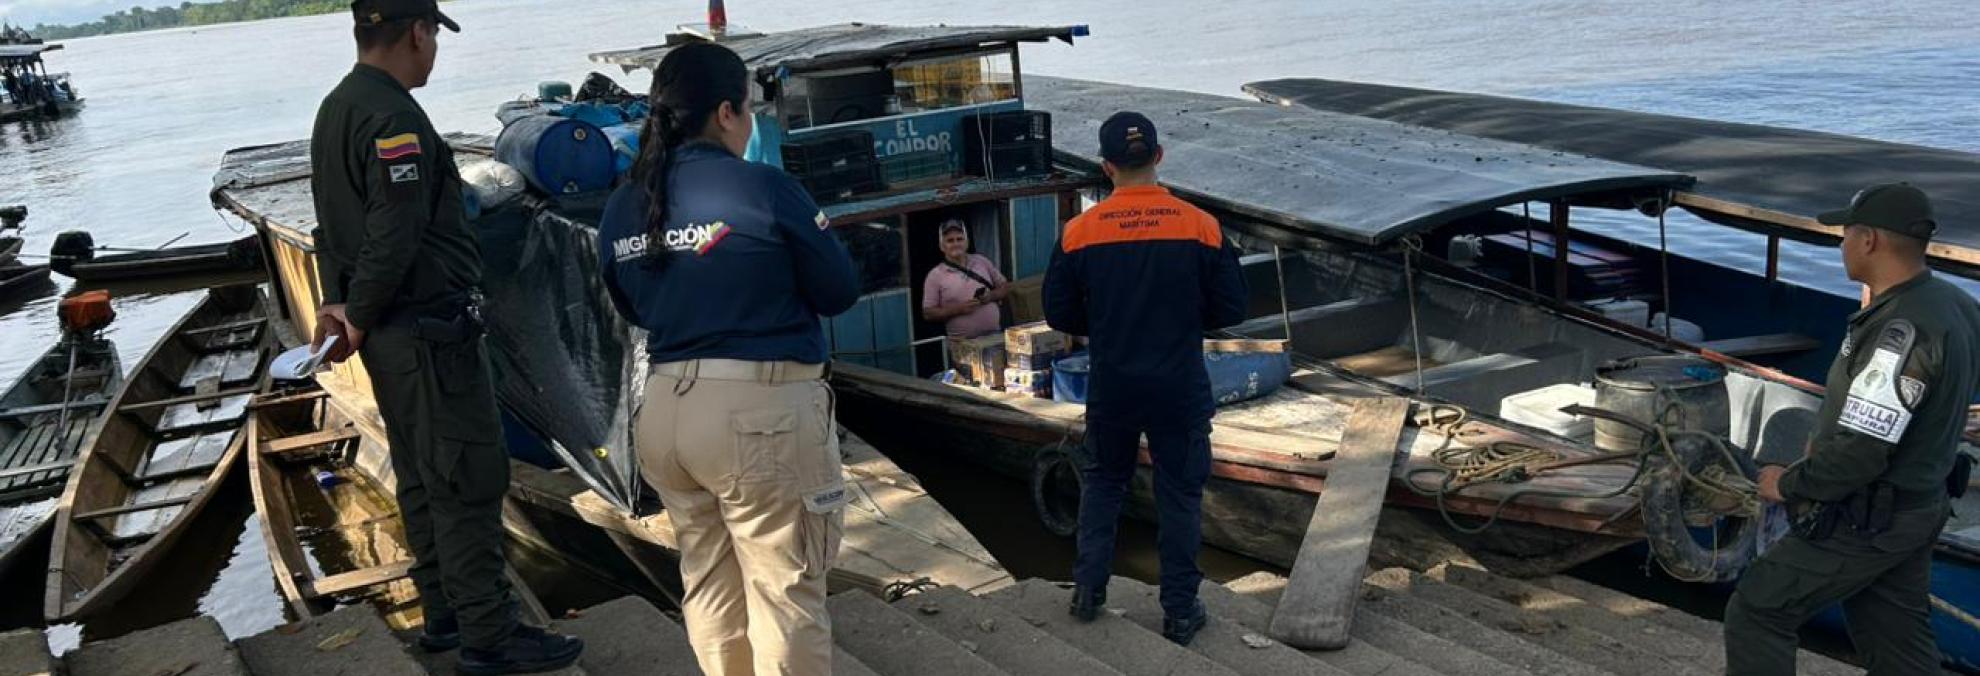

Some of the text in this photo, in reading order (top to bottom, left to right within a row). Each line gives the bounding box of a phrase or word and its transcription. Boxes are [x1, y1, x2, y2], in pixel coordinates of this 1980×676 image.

[896, 118, 919, 138] EL
[874, 131, 952, 157] CONDOR
[1098, 208, 1182, 220] DIRECCIÓN GENERAL
[613, 223, 713, 257] MIGCIÓN
